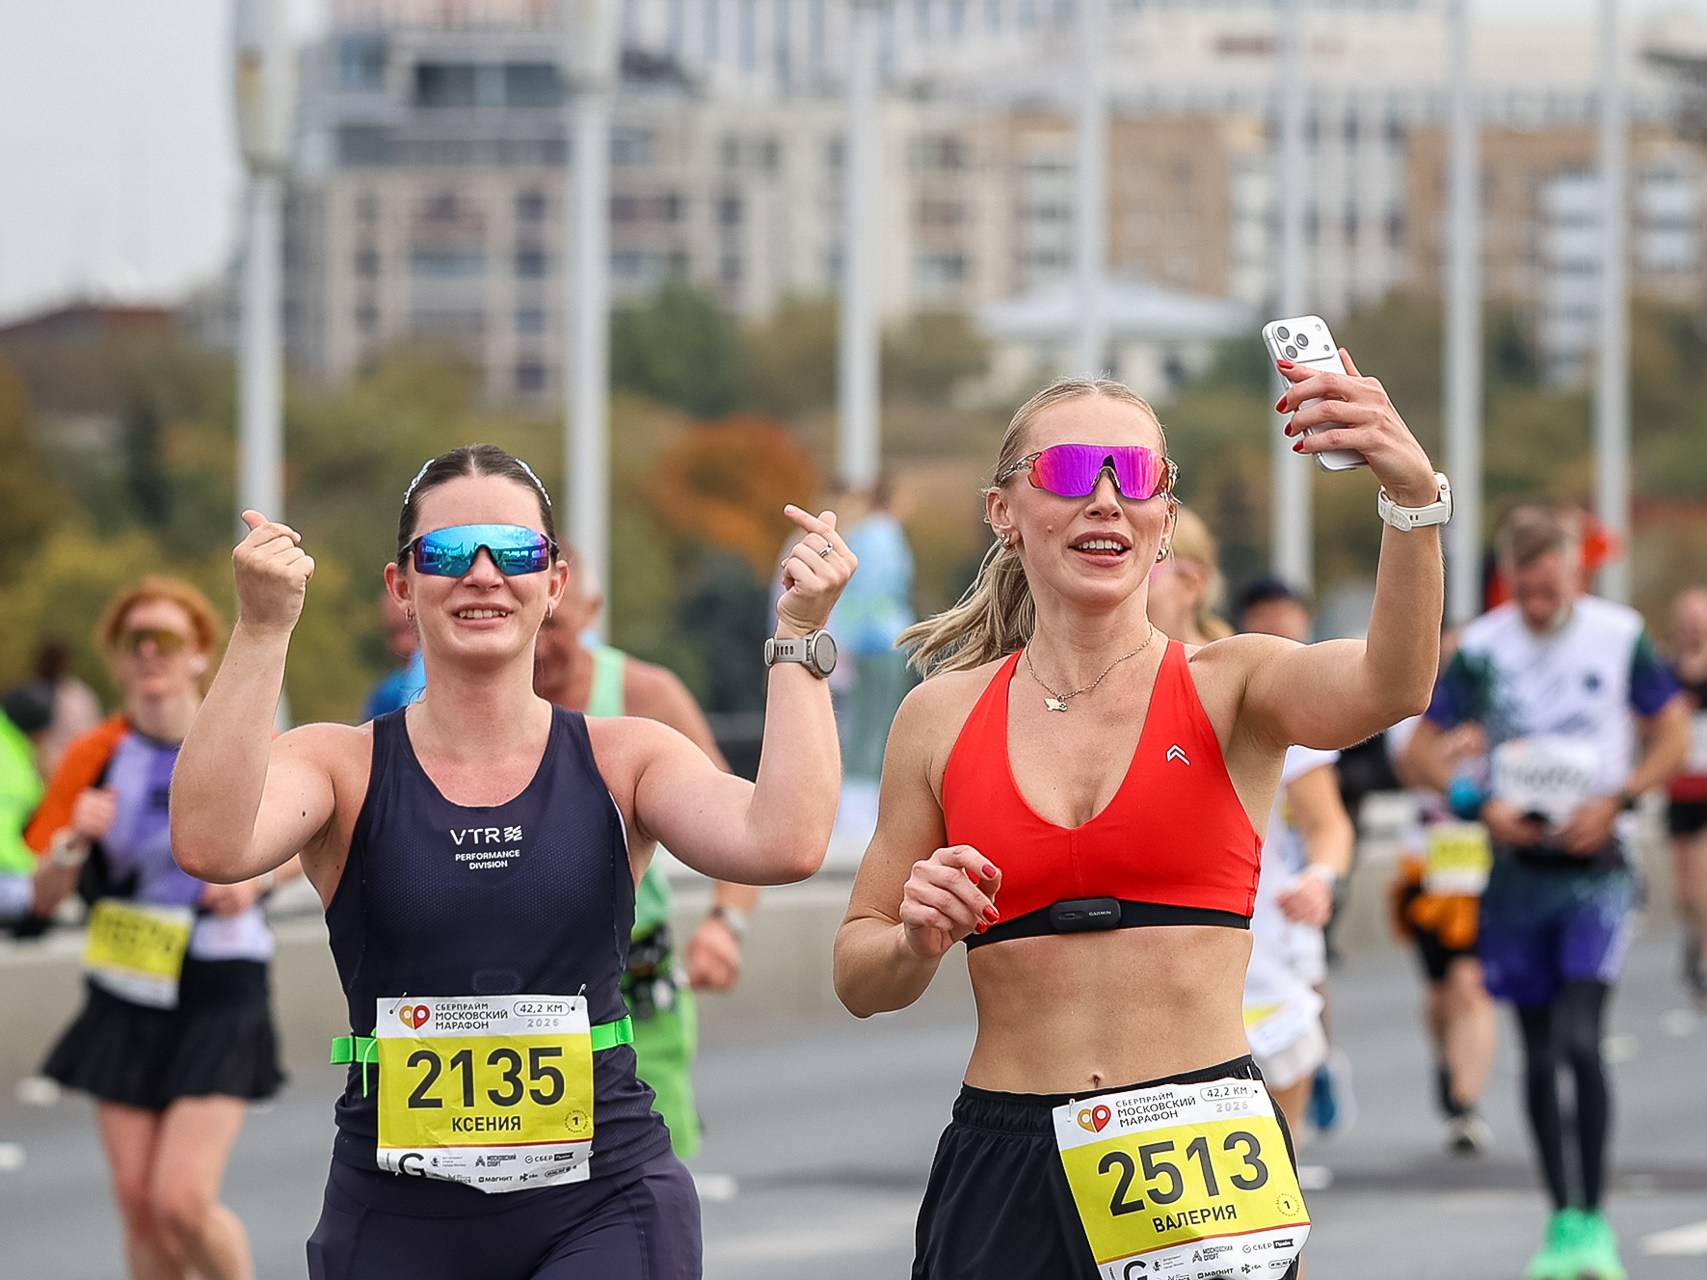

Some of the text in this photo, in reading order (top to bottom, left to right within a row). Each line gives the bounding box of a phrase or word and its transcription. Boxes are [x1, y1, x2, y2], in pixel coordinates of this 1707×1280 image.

[449, 827, 501, 846] VTR
[455, 849, 521, 862] PERFORMANCE
[468, 860, 509, 871] DIVISION
[435, 1001, 489, 1012] СБЕРПРАЙМ
[519, 1004, 543, 1014] 42,2
[435, 1009, 509, 1021] МОСКОВСКИЙ
[435, 1019, 490, 1031] МАРАФОН
[406, 1046, 566, 1109] 2135
[1206, 1086, 1230, 1098] 42,2
[1115, 1091, 1175, 1108] СБЕРПРАЙМ
[1117, 1096, 1197, 1118] МОСКОВСКИЙ
[1215, 1101, 1249, 1113] 2026
[452, 1115, 522, 1132] КСЕНИЯ
[572, 1116, 579, 1126] 1
[1119, 1110, 1179, 1128] МАРАФОН
[398, 1152, 427, 1178] G
[1099, 1131, 1268, 1216] 2513
[1283, 1200, 1291, 1210] 1
[1152, 1204, 1237, 1232] ВАЛЕРИЯ
